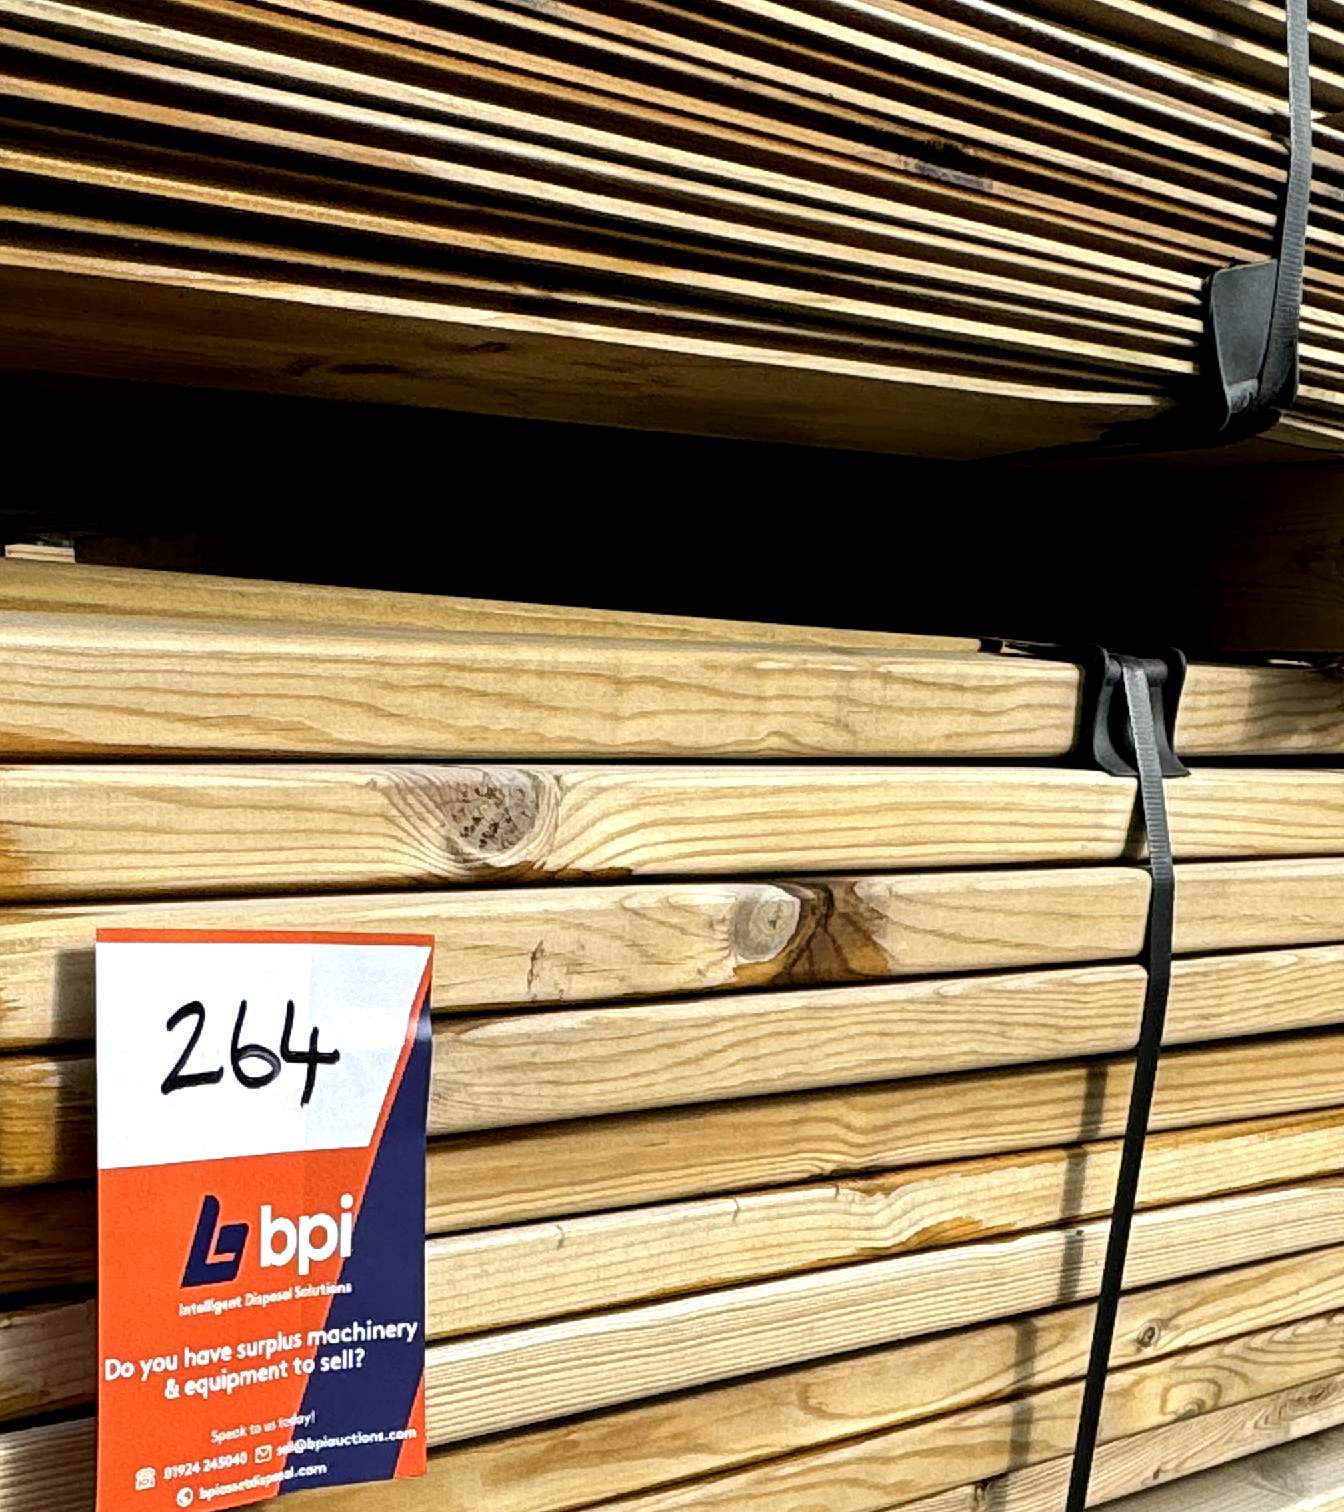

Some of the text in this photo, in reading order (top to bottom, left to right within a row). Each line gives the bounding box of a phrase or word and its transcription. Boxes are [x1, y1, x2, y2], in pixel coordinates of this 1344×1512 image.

[161, 1000, 340, 1108] 264
[259, 1193, 354, 1276] bpi
[178, 1281, 353, 1317] Intelligent Disposal Solutions
[104, 1319, 418, 1382] Do you have surplus machinery
[164, 1347, 367, 1400] & equipment to sell?
[210, 1409, 317, 1445] Speak to us today!
[163, 1460, 202, 1480] 01924
